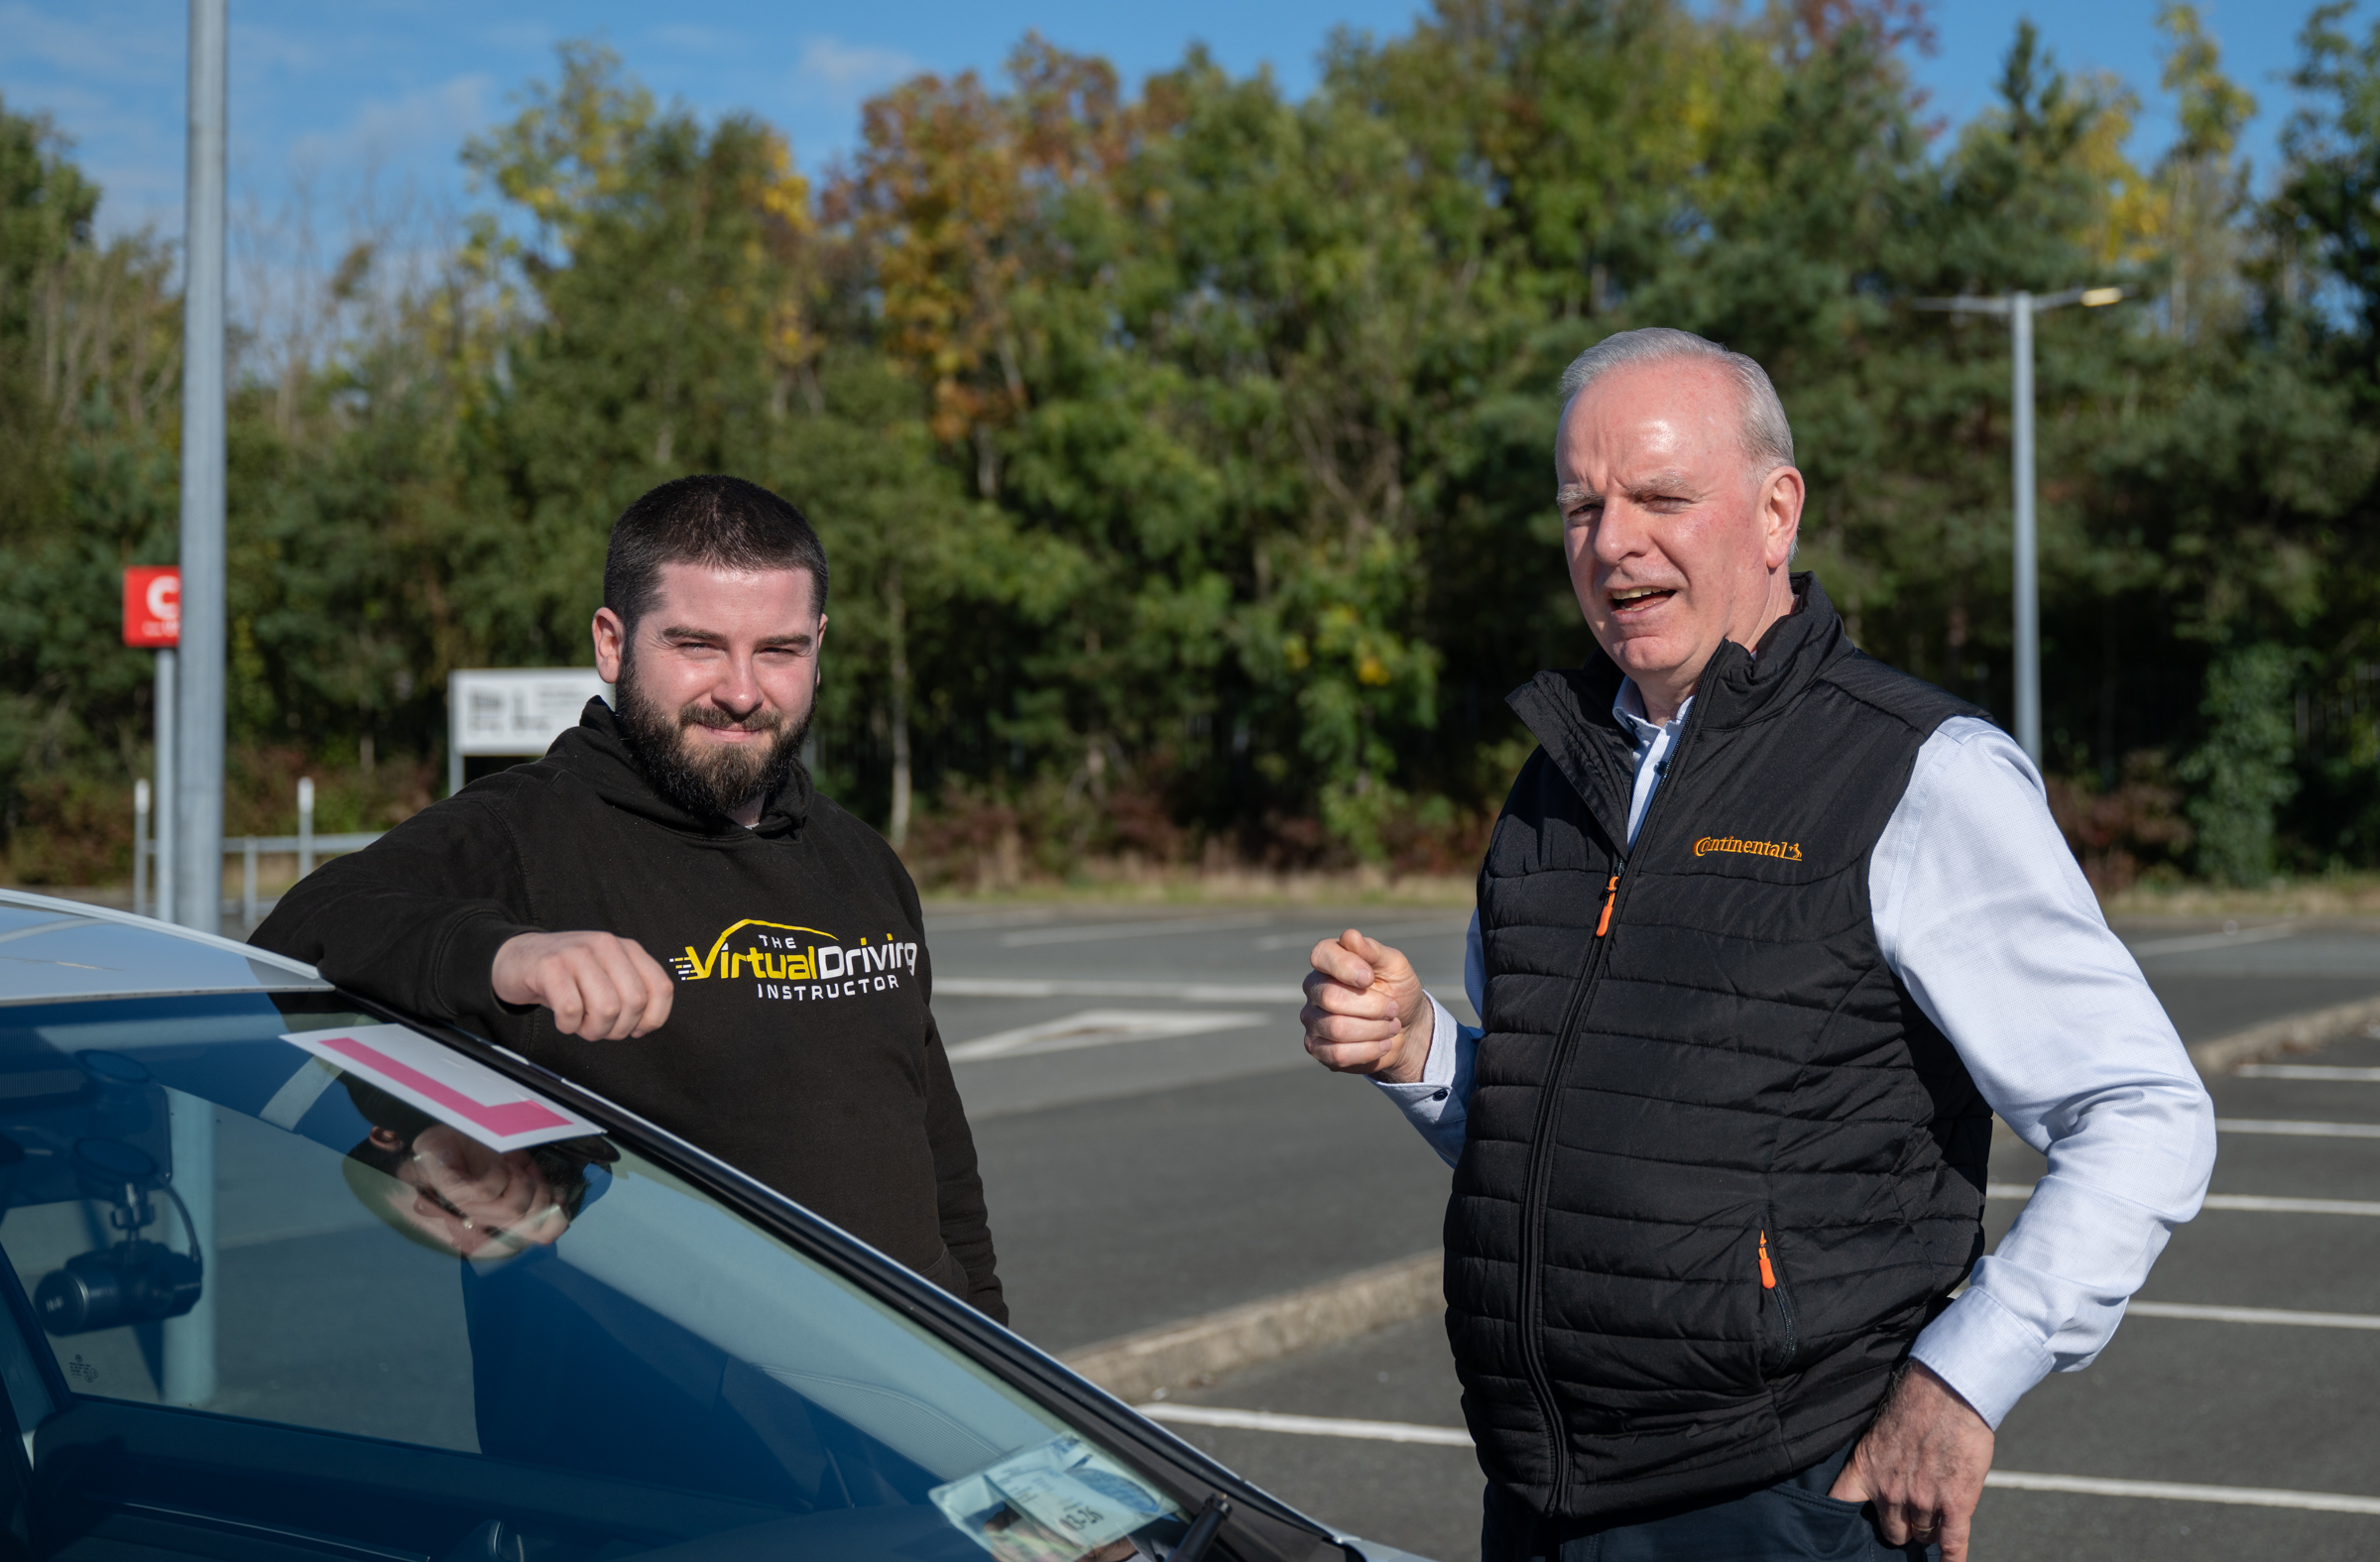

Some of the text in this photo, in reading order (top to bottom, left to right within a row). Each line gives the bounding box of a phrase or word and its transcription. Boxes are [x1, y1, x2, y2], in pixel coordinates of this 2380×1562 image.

[1693, 836, 1787, 859] Continental
[759, 934, 797, 949] THE
[757, 974, 899, 1001] INSTRUCTOR
[317, 1036, 574, 1138] L
